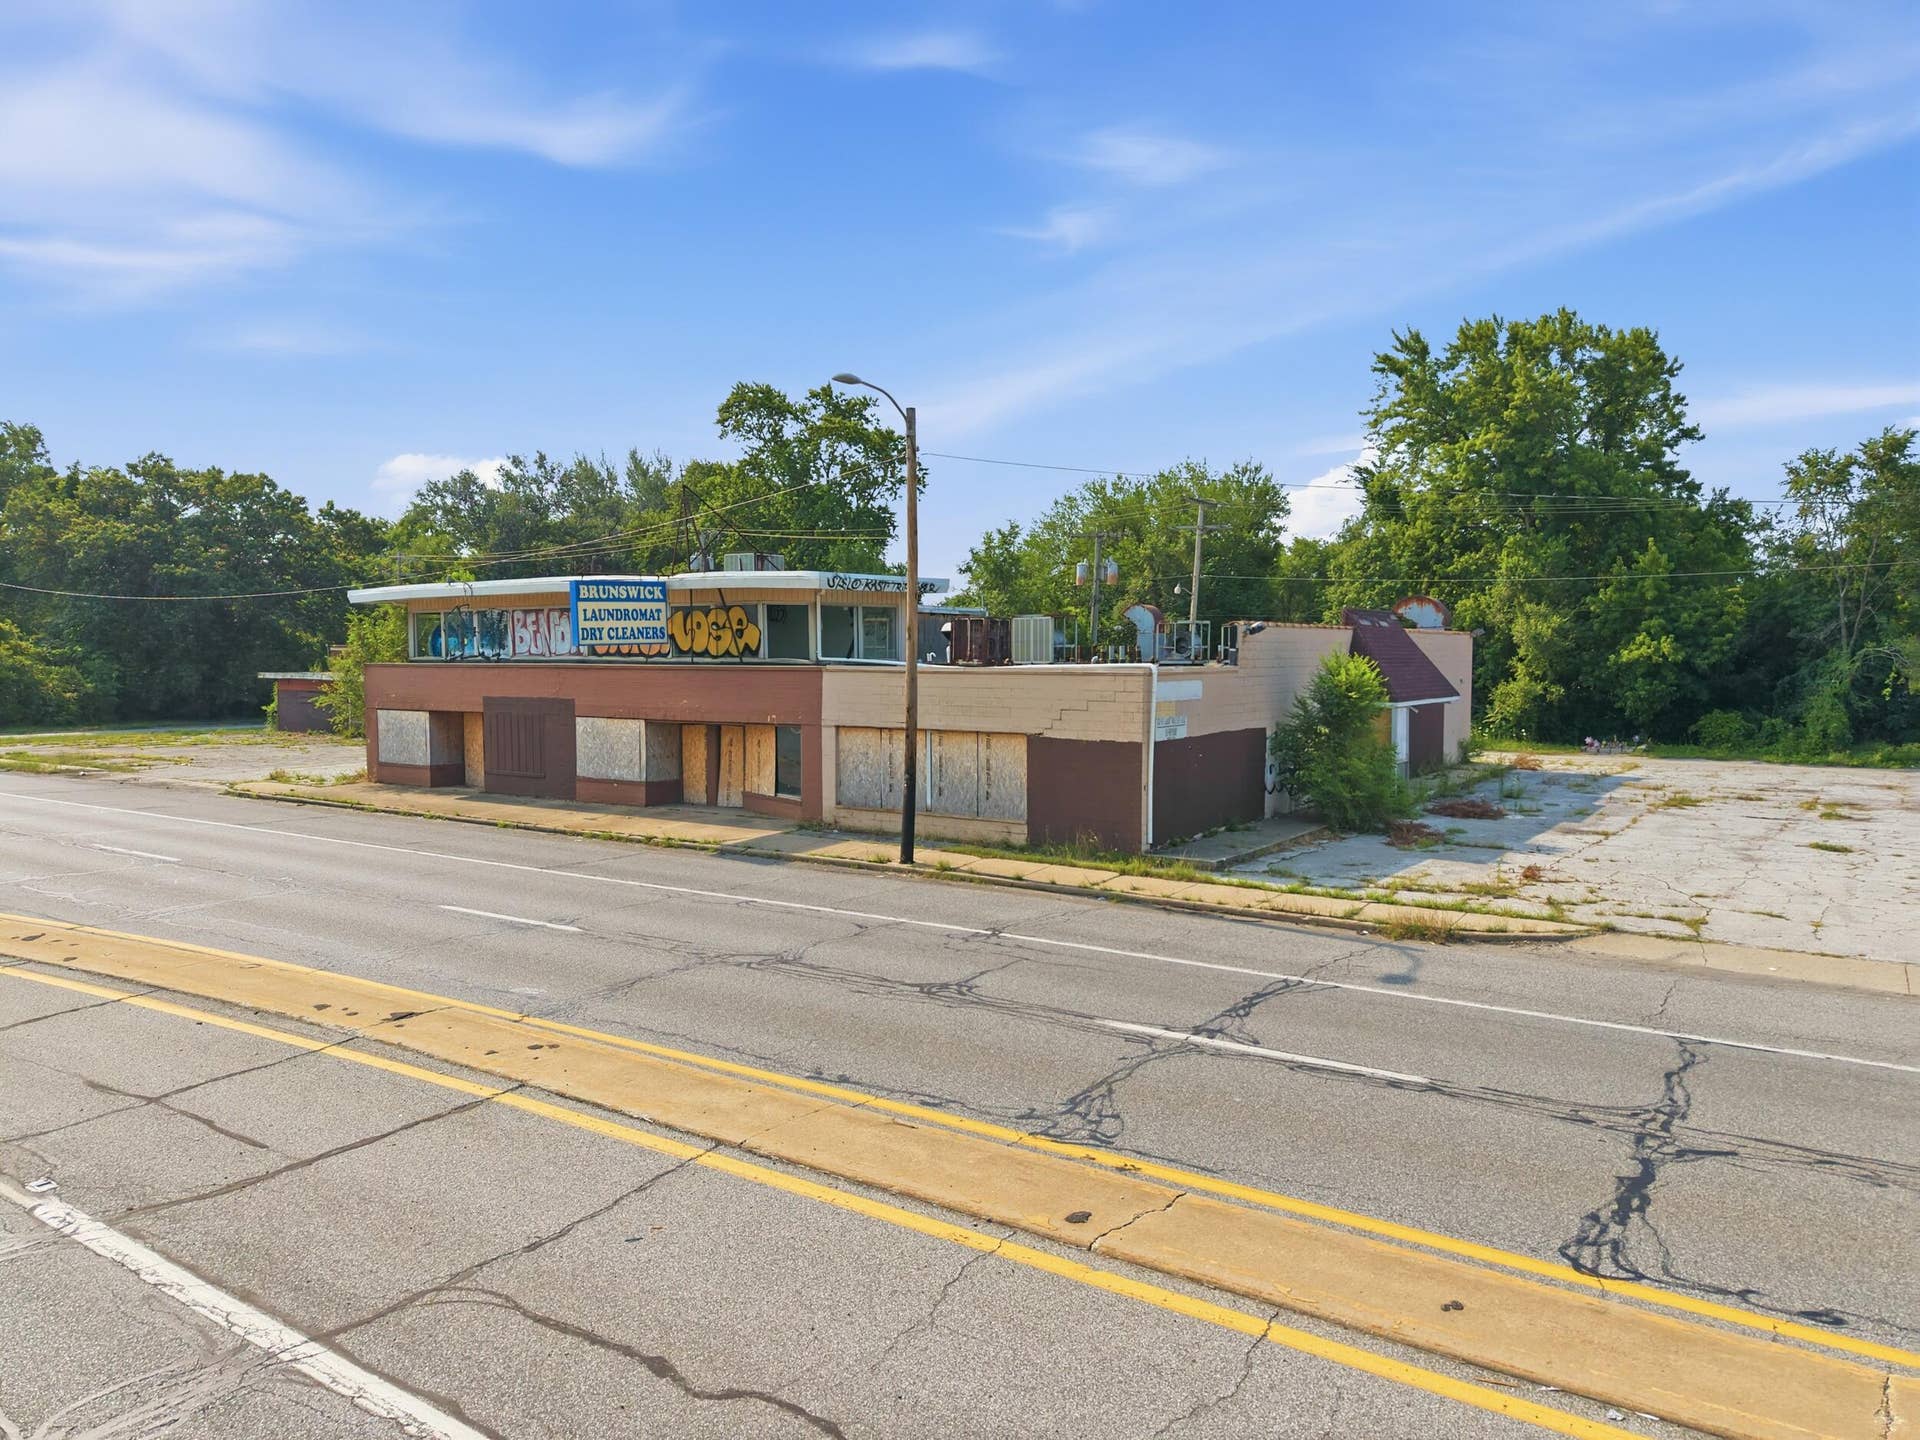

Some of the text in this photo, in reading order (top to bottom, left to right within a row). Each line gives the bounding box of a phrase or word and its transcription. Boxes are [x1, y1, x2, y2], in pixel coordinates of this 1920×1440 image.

[579, 584, 664, 600] BRUNSWICK
[582, 608, 662, 622] LAUNDROMAT
[580, 626, 666, 641] DRY CLEANERS
